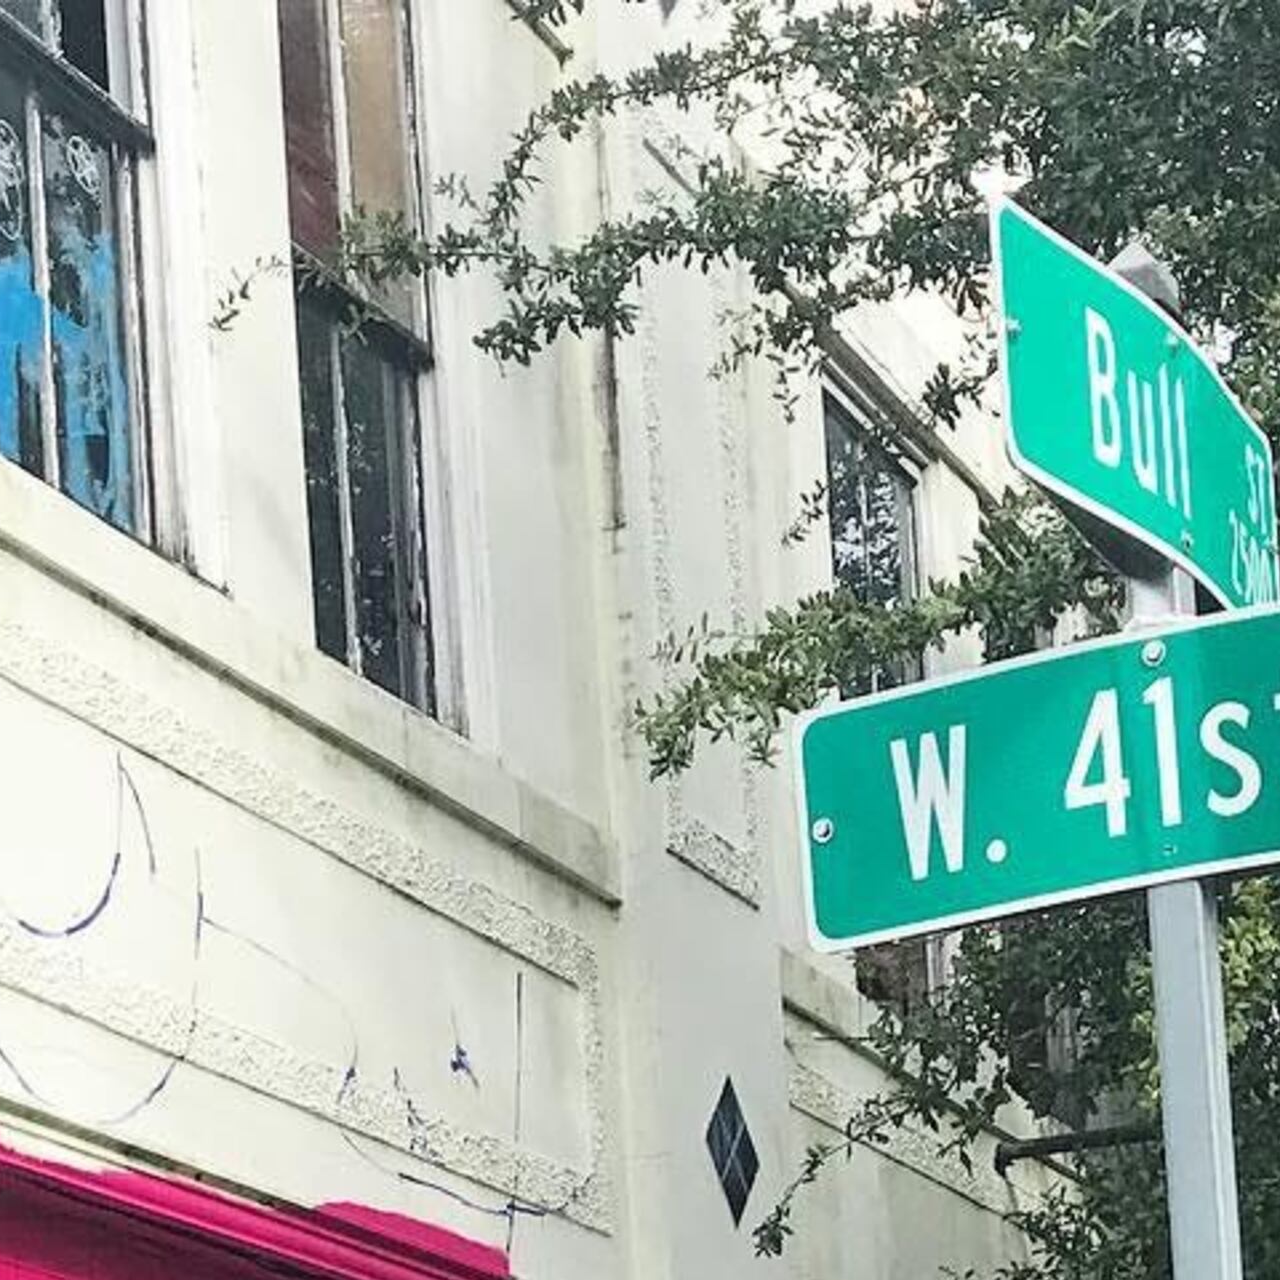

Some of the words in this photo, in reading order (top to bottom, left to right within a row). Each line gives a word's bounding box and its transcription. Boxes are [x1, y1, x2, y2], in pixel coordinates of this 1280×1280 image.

[1084, 305, 1193, 521] Bull
[1244, 442, 1268, 535] ST
[888, 722, 1010, 882] W.
